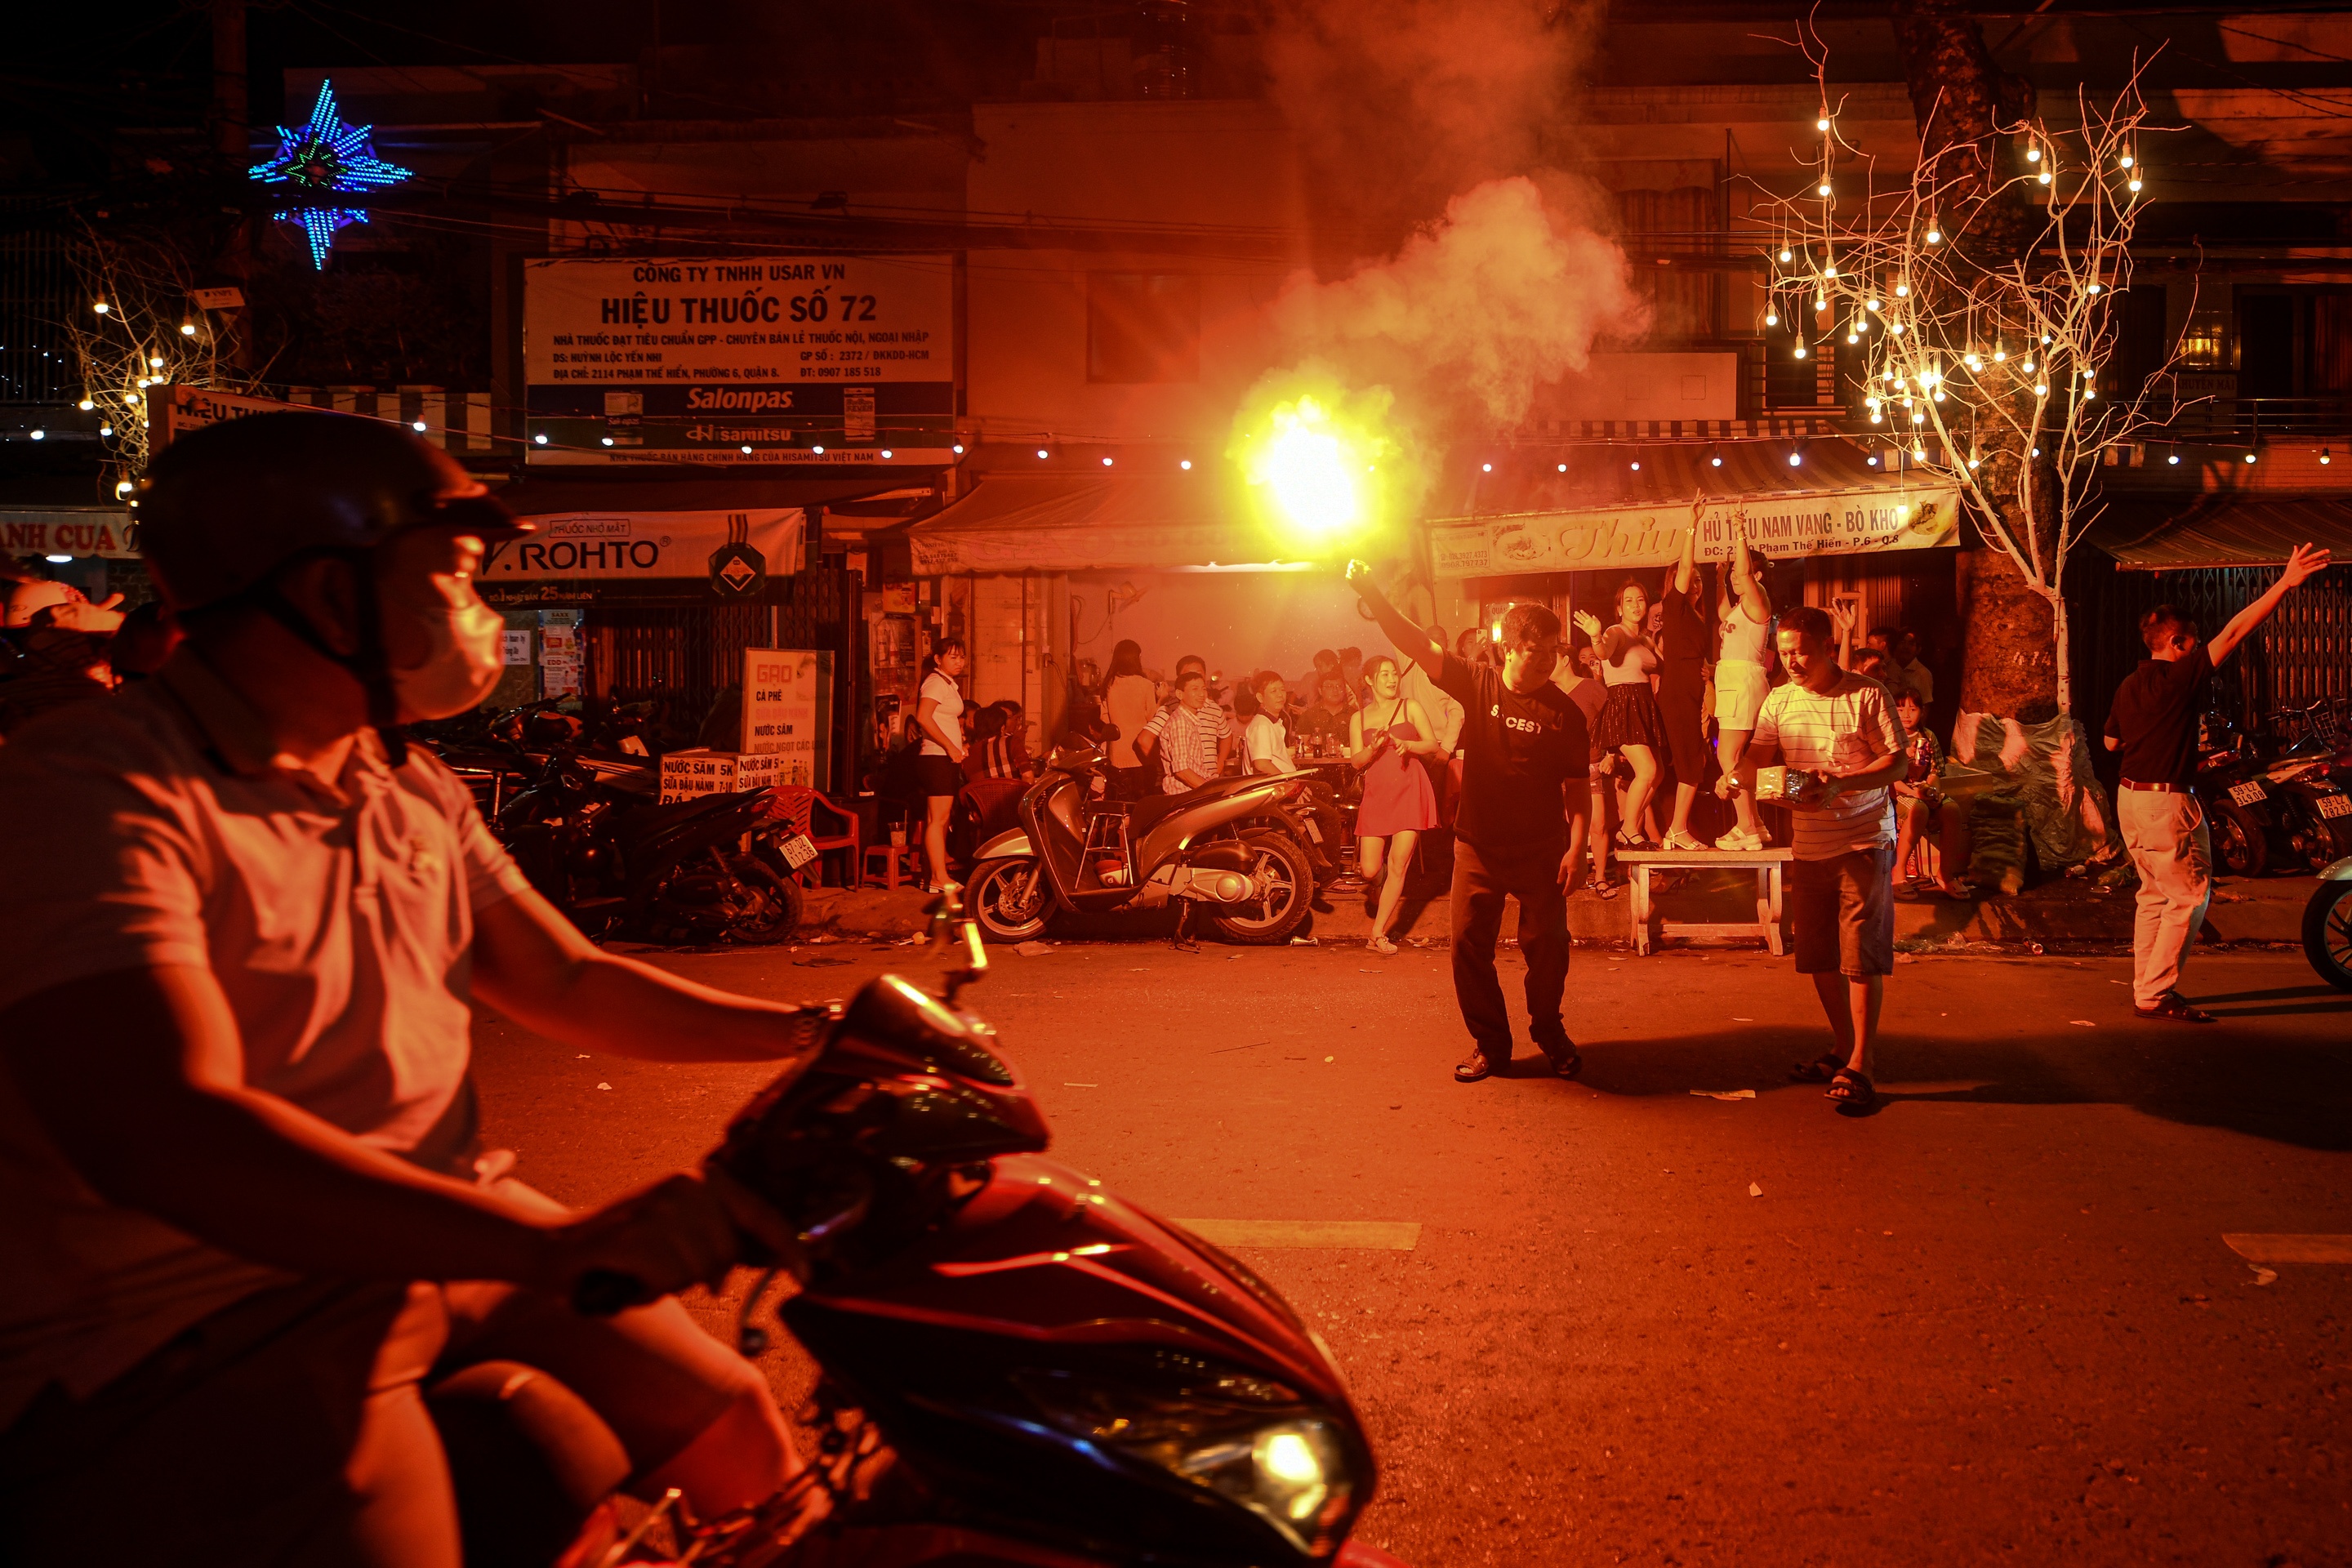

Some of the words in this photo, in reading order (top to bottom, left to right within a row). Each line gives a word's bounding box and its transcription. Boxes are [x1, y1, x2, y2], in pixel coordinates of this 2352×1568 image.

[634, 262, 682, 283] CÔNG
[687, 266, 709, 283] TY
[715, 265, 763, 282] TNHH
[769, 265, 815, 281] USAR
[822, 264, 846, 280] VN
[601, 291, 670, 329] HIỆU
[679, 287, 781, 324] THUỐC
[789, 285, 832, 323] SỐ
[840, 295, 877, 322] 72
[553, 332, 573, 346] NHÀ
[576, 331, 610, 345] THUỐC
[612, 334, 632, 348] ĐẠT
[635, 332, 658, 345] TIÊU
[661, 329, 695, 345] CHUẨN
[697, 334, 717, 345] GPP
[726, 332, 766, 345] CHUYÊN
[768, 331, 790, 345] BÁN
[793, 329, 805, 344] LẺ
[808, 329, 843, 344] THUỐC
[868, 332, 898, 345] NGOẠI
[902, 329, 929, 343] NHẬP
[553, 353, 569, 363] DS:
[571, 350, 602, 363] HUỲNH
[604, 350, 622, 364] LỘC
[646, 352, 662, 363] NHI
[800, 350, 813, 361] GP
[815, 348, 828, 361] SỐ
[840, 350, 863, 360] 2372
[553, 368, 568, 381] ĐỊA
[591, 368, 614, 379] 2114
[617, 368, 644, 381] PHẠM
[646, 365, 663, 378] THẾ
[694, 366, 731, 378] PHƯỜNG
[744, 366, 768, 380] QUẬN
[800, 367, 815, 377] ĐT:
[817, 367, 841, 377] 0907
[844, 367, 862, 377] 185
[863, 367, 881, 377] 518
[686, 387, 794, 413] Salonpas
[685, 424, 792, 442] Hisamitsu
[681, 452, 705, 462] HÀNG
[707, 451, 734, 462] CHÍNH
[737, 452, 760, 462] HÀNG
[763, 450, 780, 462] CỦA
[782, 452, 831, 462] HISAMITSU
[833, 451, 851, 464] VIỆT
[854, 452, 875, 462] NAM
[1704, 511, 1722, 542] HỦ
[1762, 516, 1793, 539] NAM
[1795, 512, 1833, 537] VANG
[1845, 505, 1865, 532] BÒ
[1869, 507, 1900, 532] KHO
[0, 523, 47, 549] NH
[1704, 546, 1723, 557] ĐC:
[1759, 541, 1789, 555] Phạm
[1792, 538, 1815, 551] Thế
[1816, 535, 1842, 550] Hiển
[1853, 536, 1871, 547] P.6
[1882, 534, 1900, 547] Q.8
[541, 586, 559, 600] 25
[755, 688, 767, 702] CÀ
[768, 688, 782, 702] PHÊ
[755, 724, 775, 737] NƯỚC
[777, 724, 793, 736] SÂM
[664, 760, 691, 774] NƯỚC
[693, 760, 715, 775] SÂM
[719, 764, 733, 776] 5K
[739, 758, 760, 773] NƯỚC
[663, 777, 678, 791] SỮA
[695, 778, 715, 793] NÀNH
[2233, 782, 2257, 796] 59-L2
[2321, 795, 2346, 808] 59-L2
